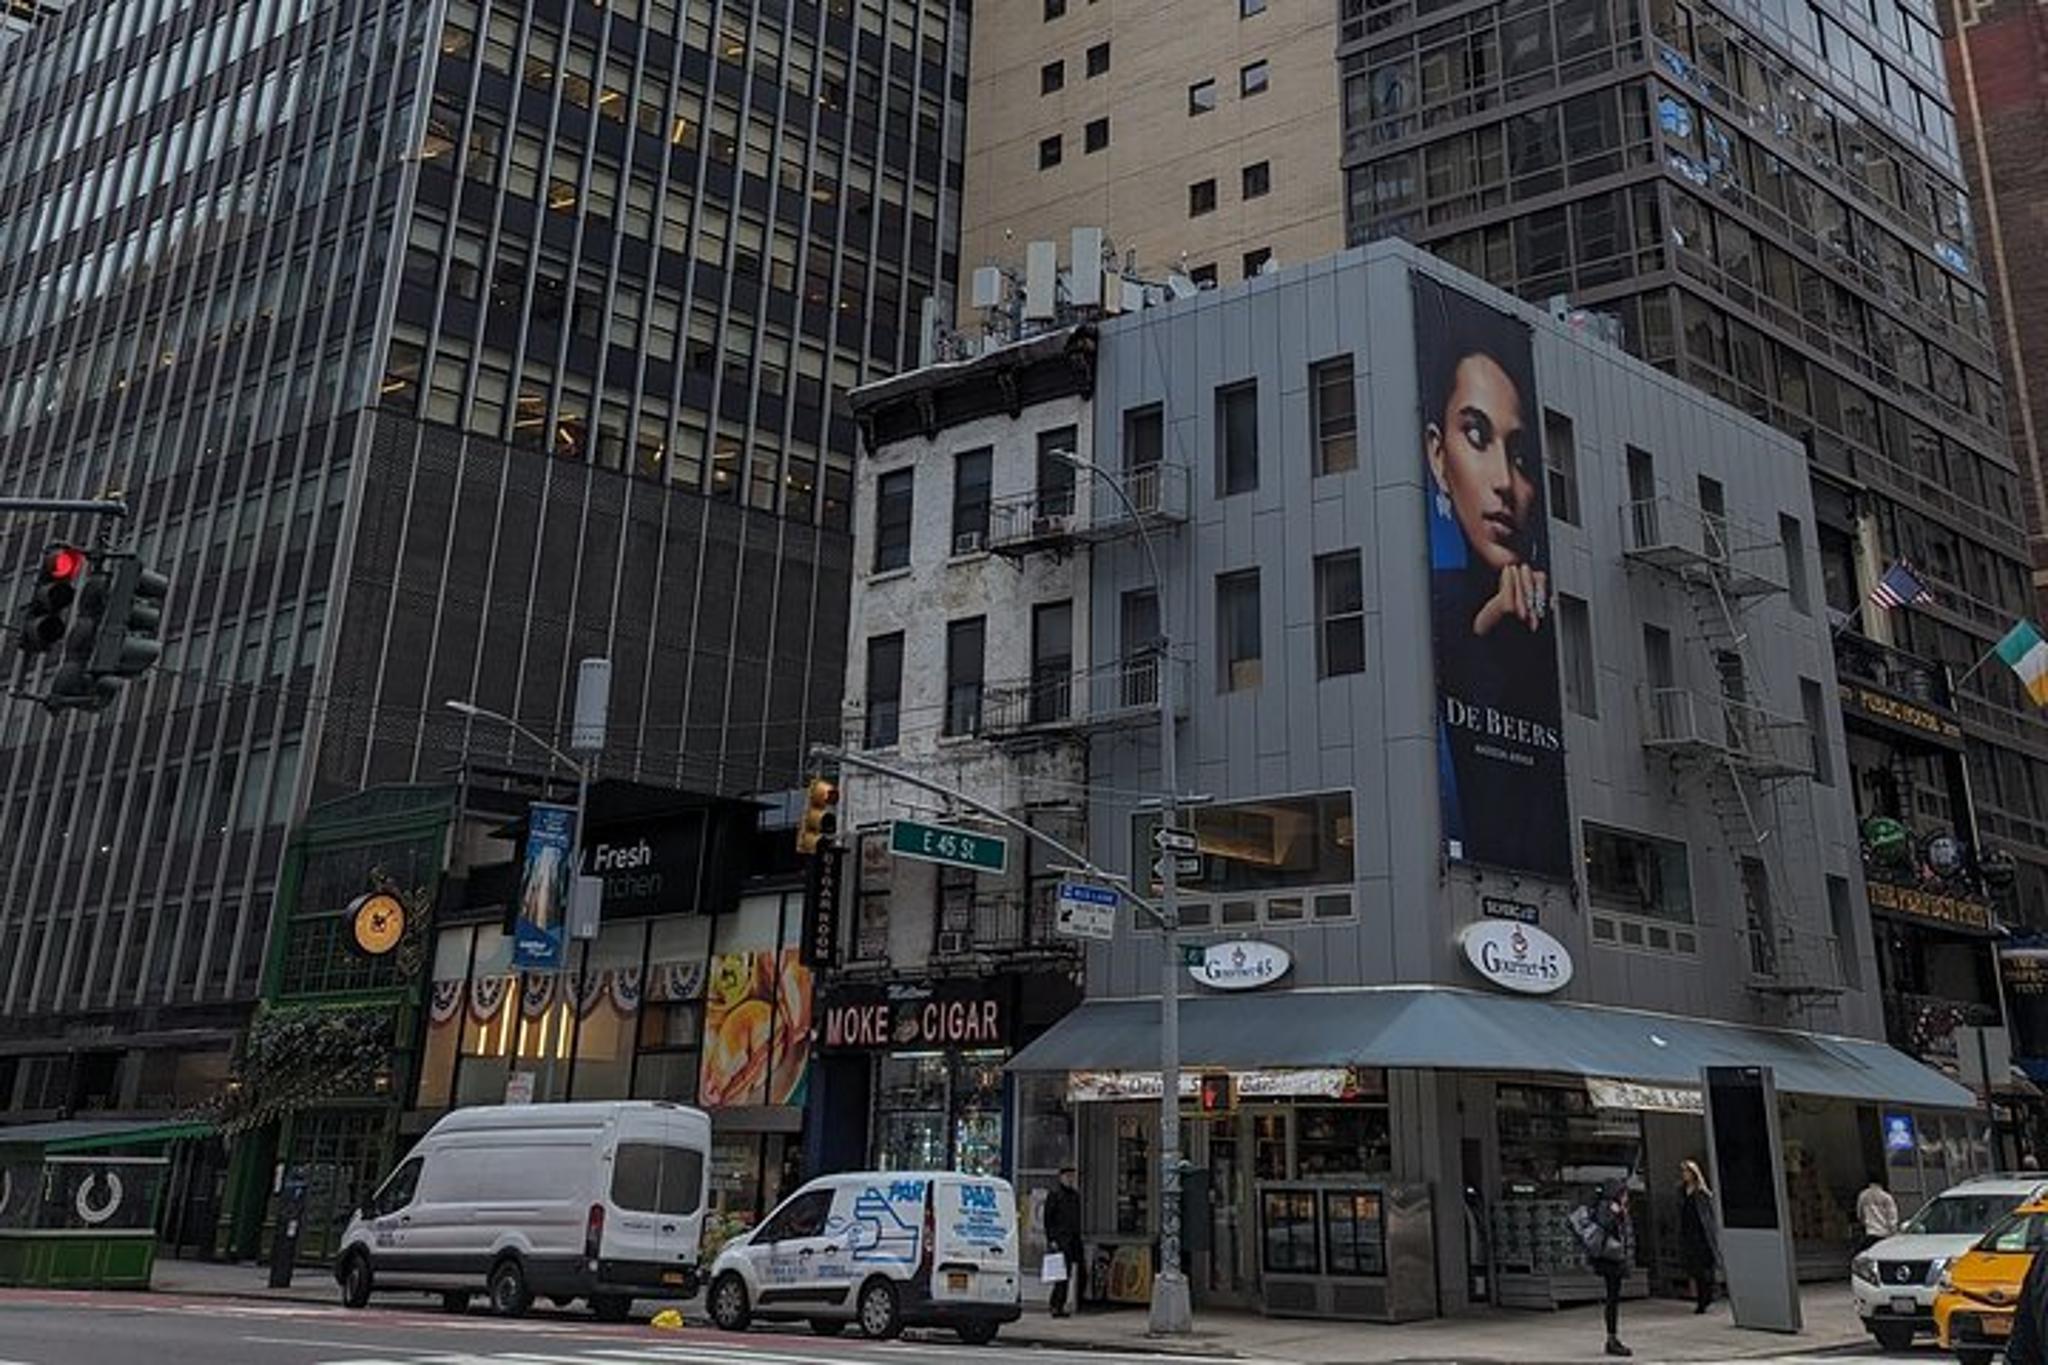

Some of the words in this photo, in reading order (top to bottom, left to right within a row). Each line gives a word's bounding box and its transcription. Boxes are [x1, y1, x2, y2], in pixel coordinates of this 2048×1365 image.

[1447, 697, 1482, 732] DE
[1486, 707, 1560, 751] BEERS
[593, 836, 651, 872] Fresh
[923, 831, 933, 852] E
[937, 837, 956, 856] 45
[922, 1000, 999, 1043] CIGAR
